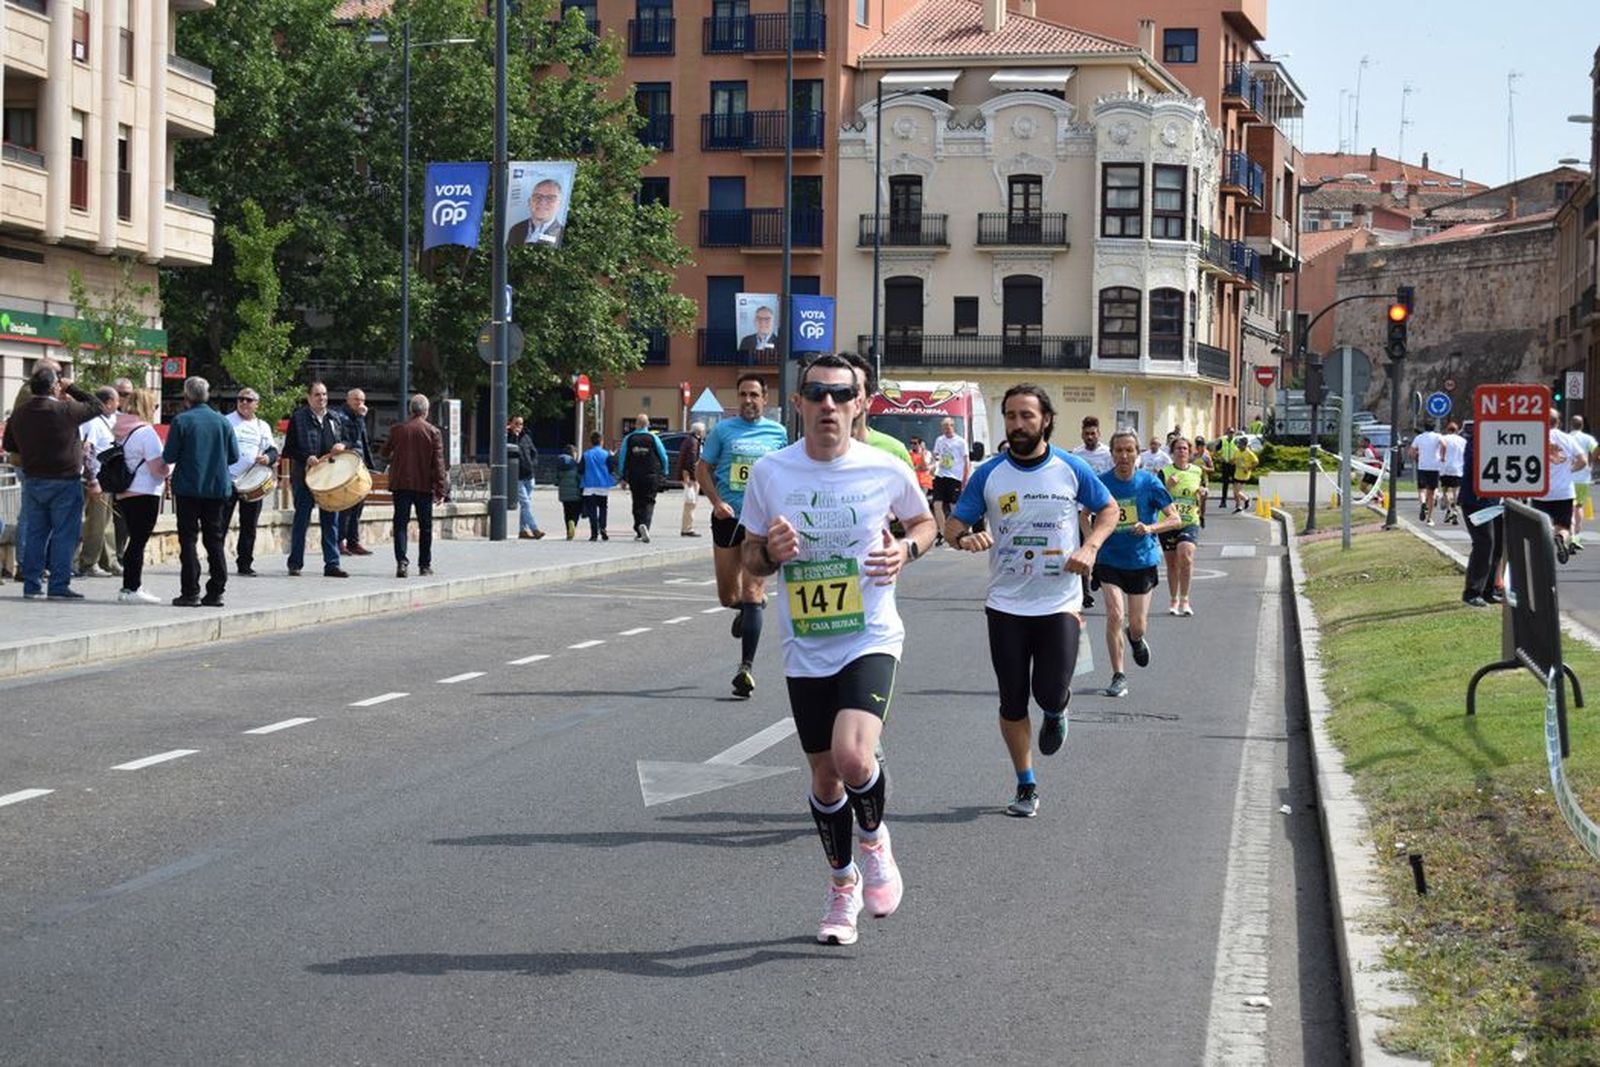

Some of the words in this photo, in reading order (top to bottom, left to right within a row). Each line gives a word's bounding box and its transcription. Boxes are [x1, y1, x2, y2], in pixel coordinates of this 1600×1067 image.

[435, 184, 472, 196] VOTA
[800, 310, 825, 319] VOTA
[1481, 394, 1543, 415] N-122
[1497, 430, 1526, 445] km
[1482, 455, 1541, 484] 459
[796, 582, 848, 614] 147
